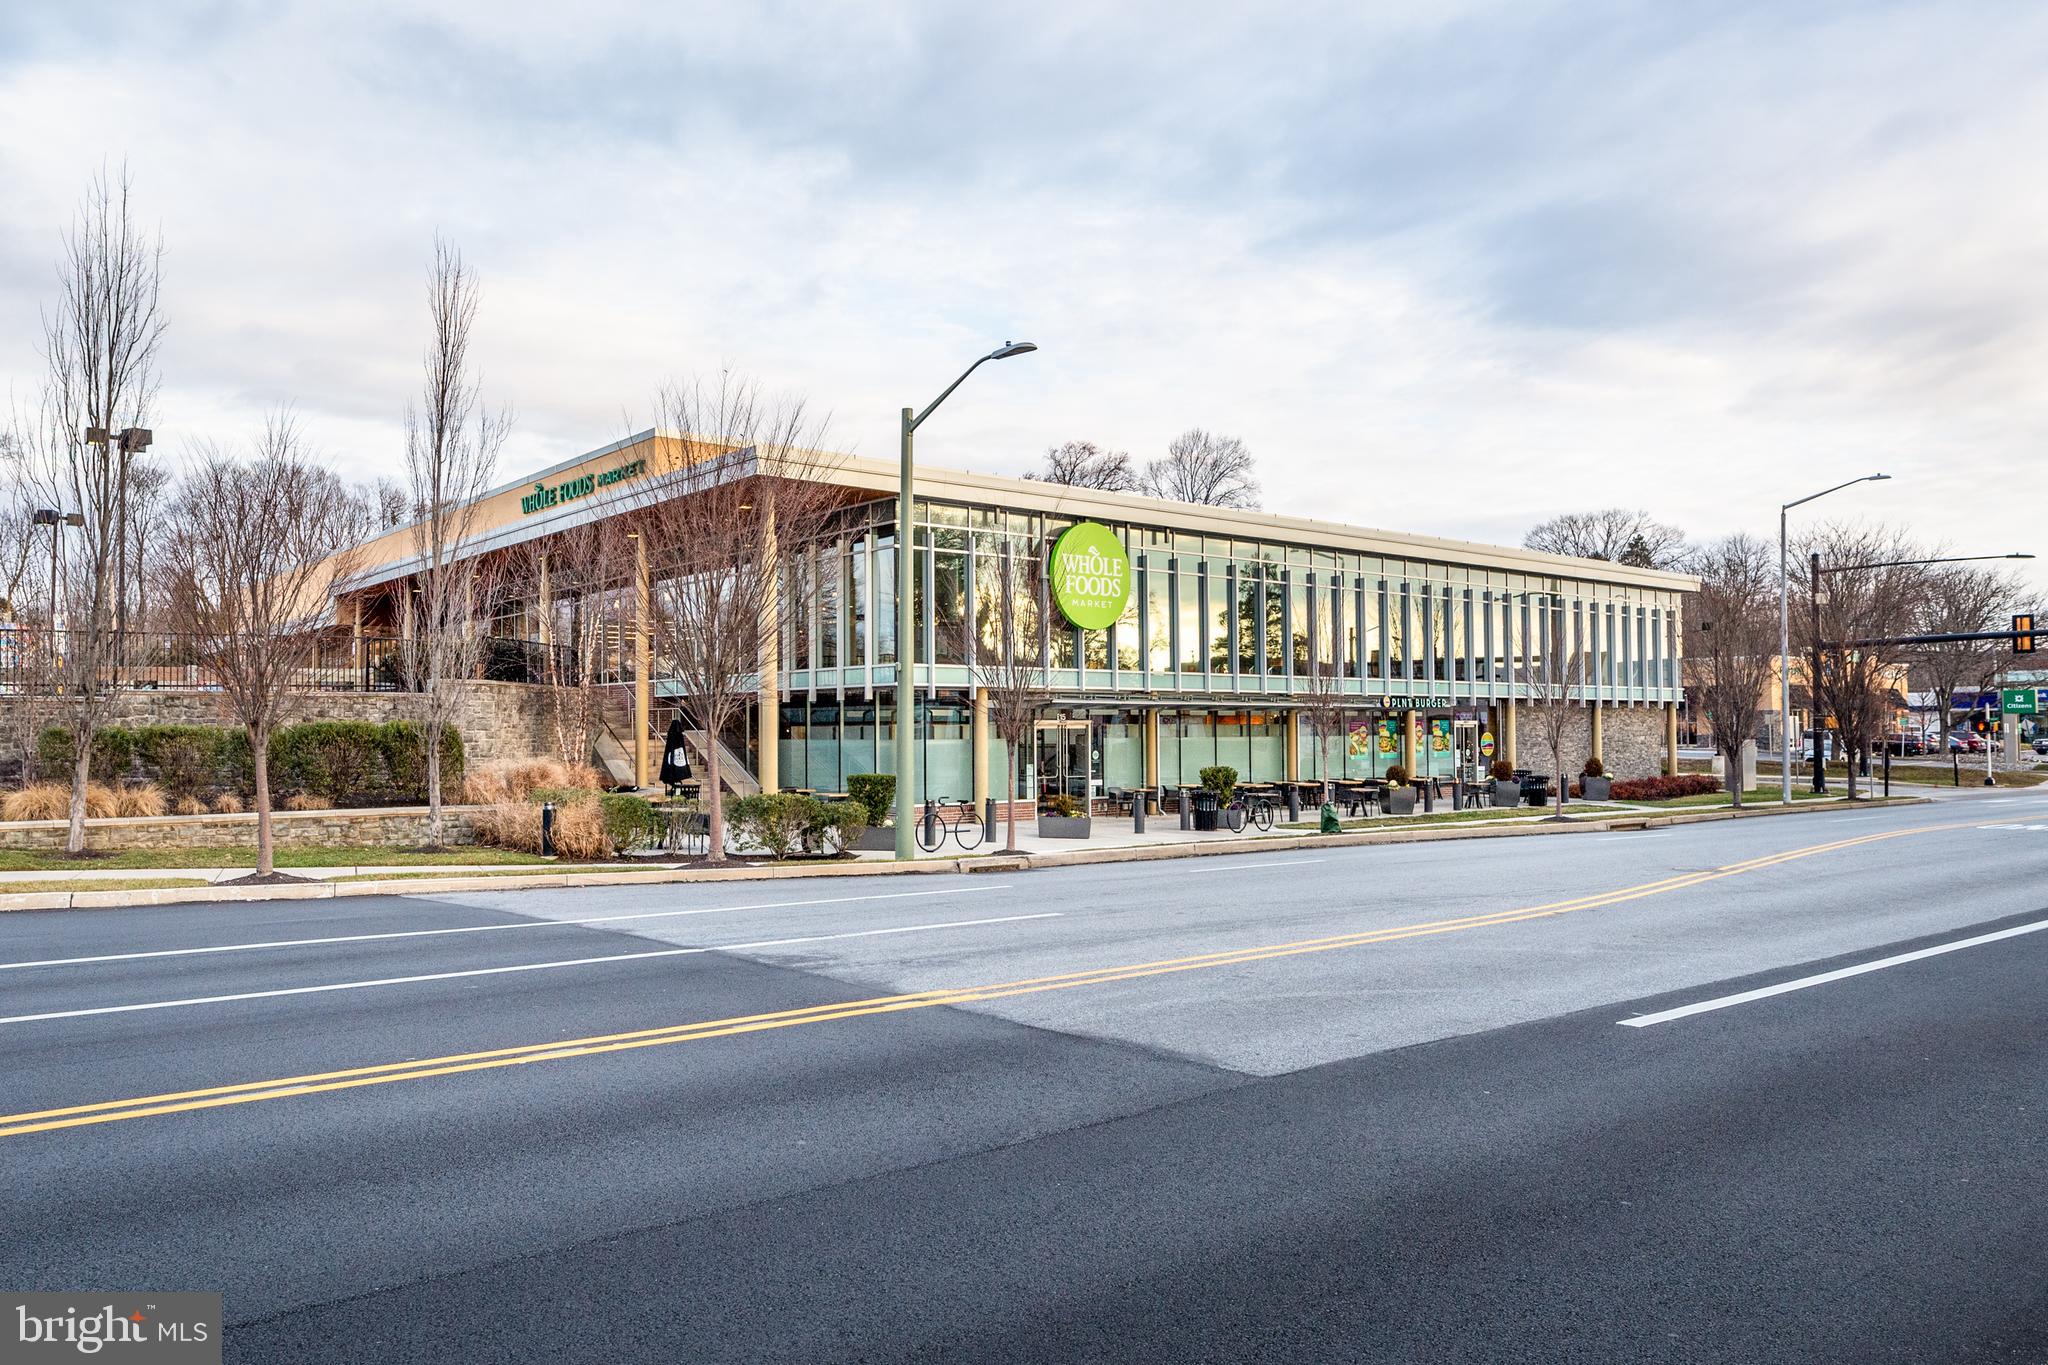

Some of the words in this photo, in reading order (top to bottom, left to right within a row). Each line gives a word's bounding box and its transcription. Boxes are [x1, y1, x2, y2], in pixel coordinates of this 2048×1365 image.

[521, 483, 558, 514] WHOLE
[559, 473, 595, 502] FOODS
[597, 459, 646, 487] MARKET
[1062, 550, 1123, 577] WHOLE
[1065, 575, 1121, 598] FOODS
[1071, 599, 1113, 609] MARKET
[1391, 698, 1412, 708] PLNT
[1415, 698, 1447, 708] BURGER
